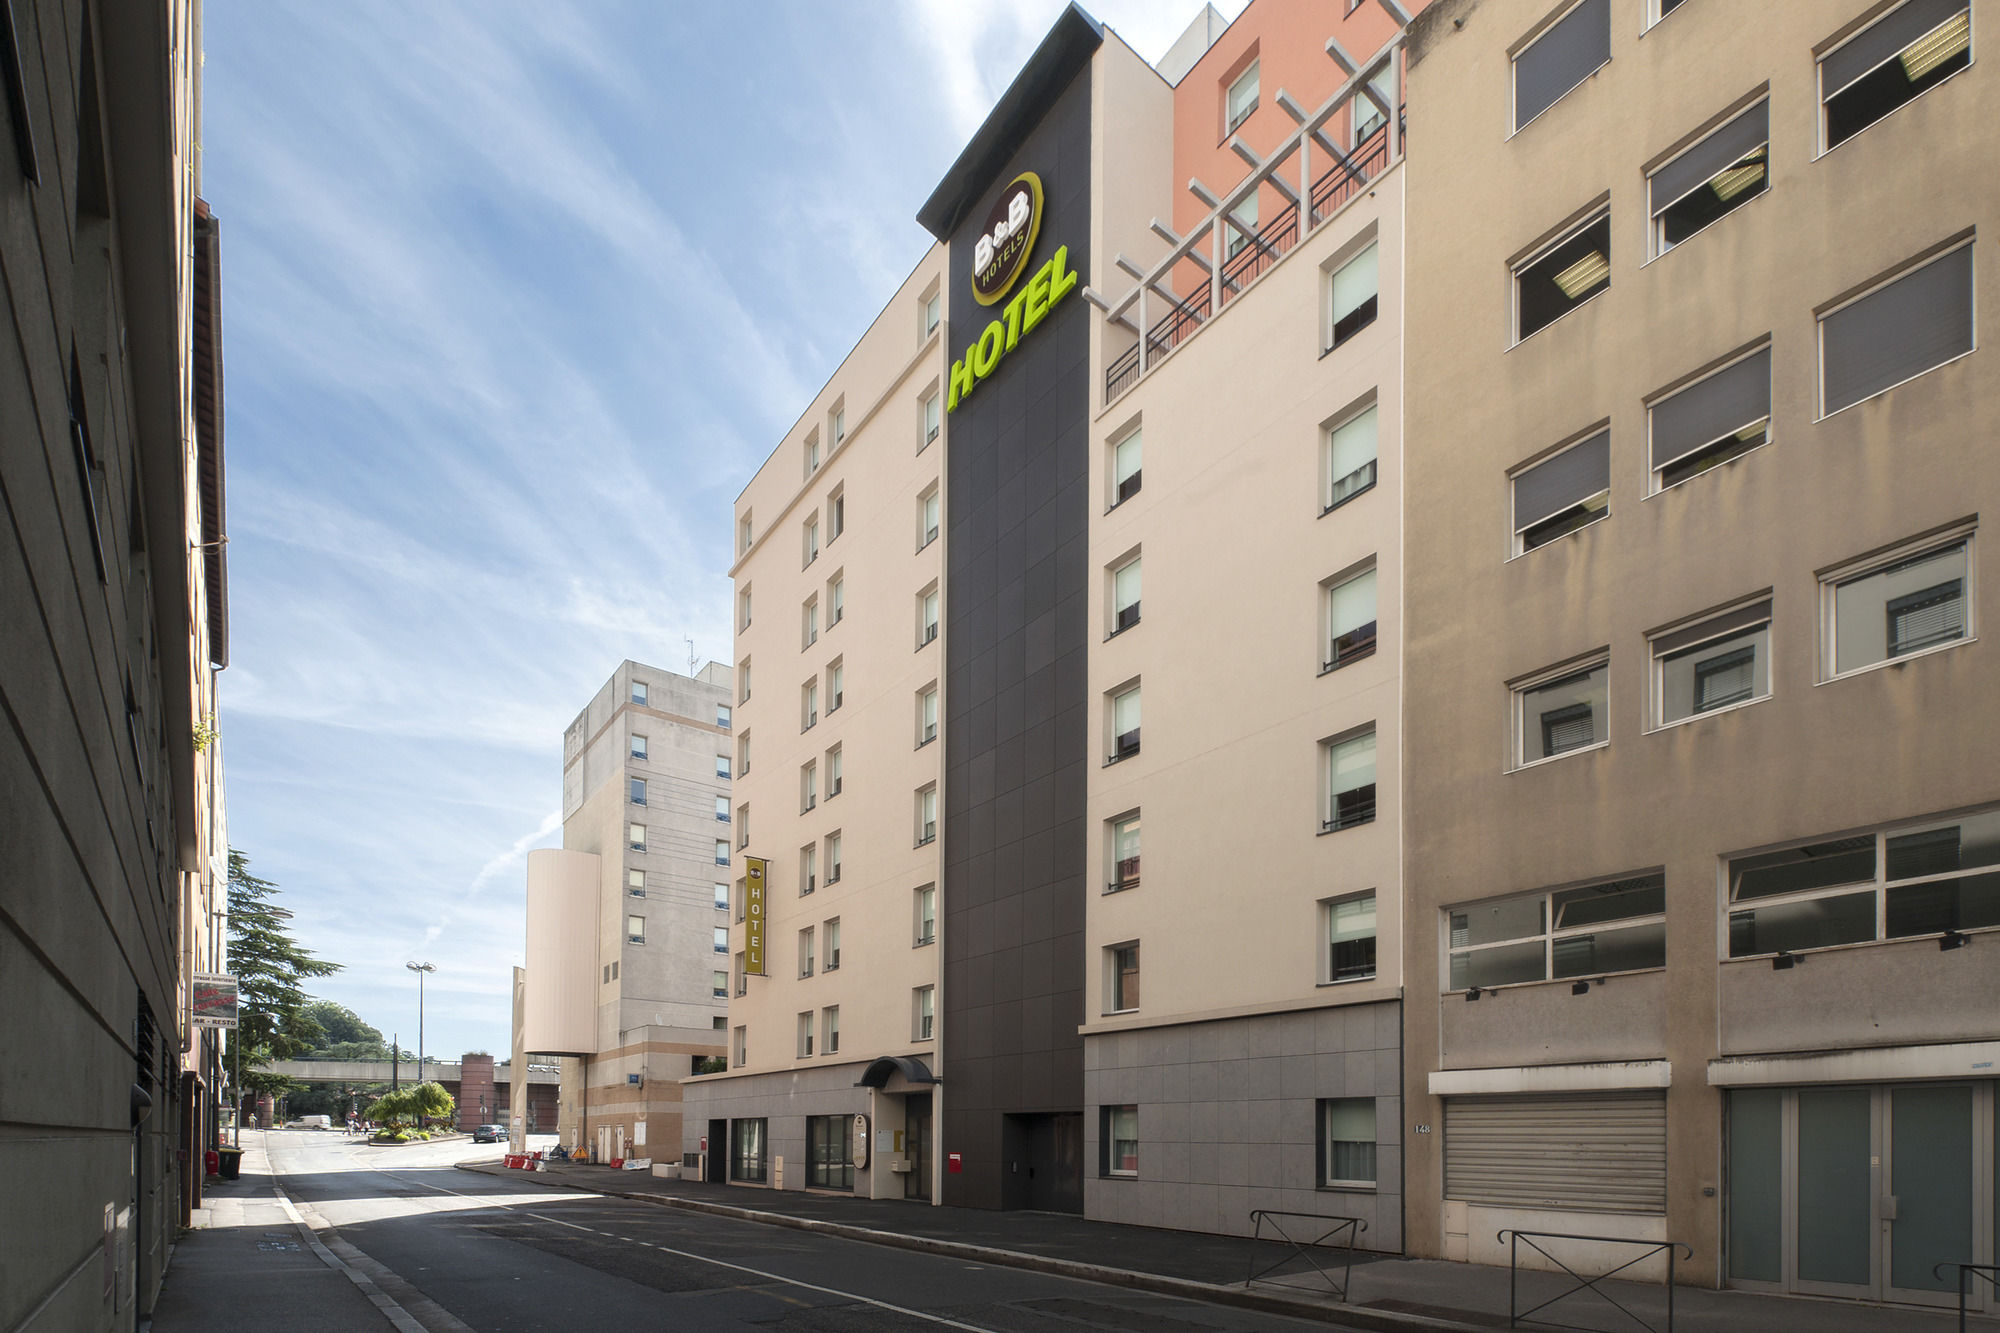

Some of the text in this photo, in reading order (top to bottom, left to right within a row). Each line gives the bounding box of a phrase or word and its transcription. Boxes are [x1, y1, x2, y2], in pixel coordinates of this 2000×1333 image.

[975, 191, 1030, 277] B&B
[983, 230, 1024, 287] HOTELS
[947, 245, 1078, 413] HOTEL
[751, 887, 760, 963] HOTEL
[1415, 1125, 1430, 1134] 148
